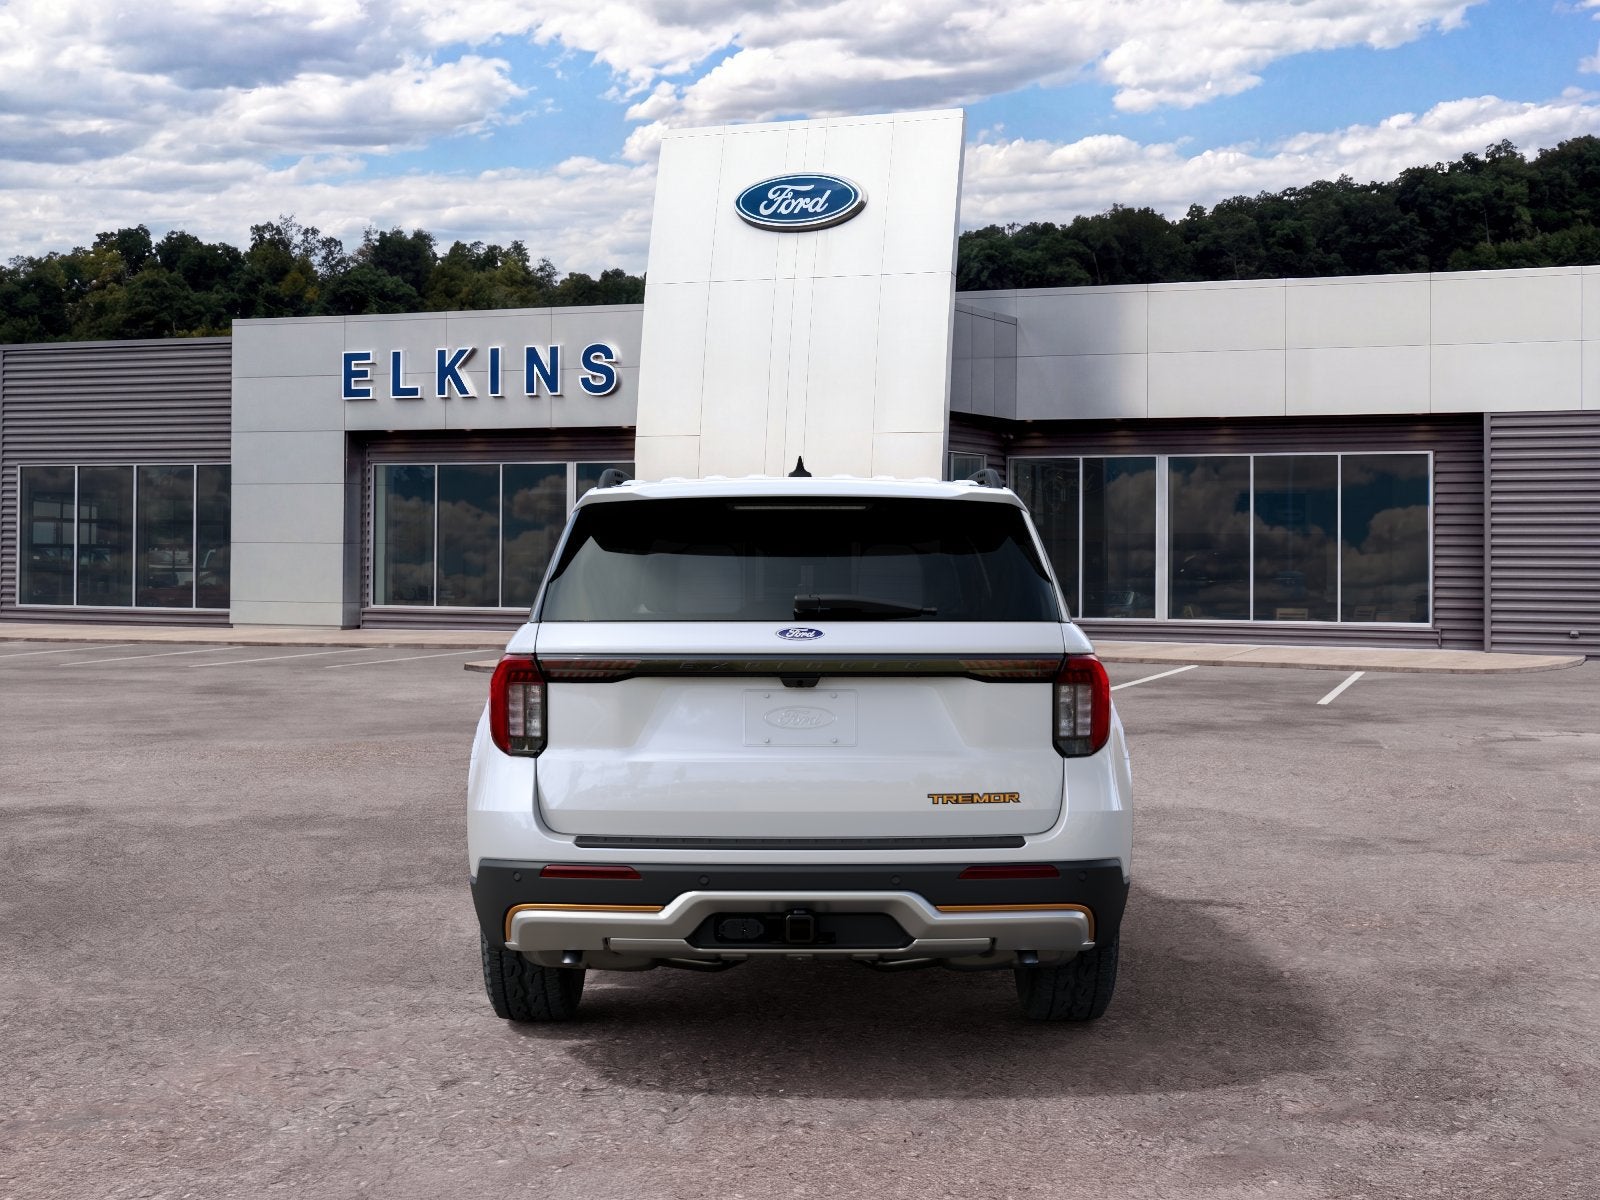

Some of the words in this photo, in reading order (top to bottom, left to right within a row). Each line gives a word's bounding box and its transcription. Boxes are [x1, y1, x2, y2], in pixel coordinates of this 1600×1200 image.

[759, 184, 832, 215] Ford
[341, 342, 618, 400] ELKINS
[785, 628, 816, 638] Ford
[927, 792, 1021, 805] TREMOR
